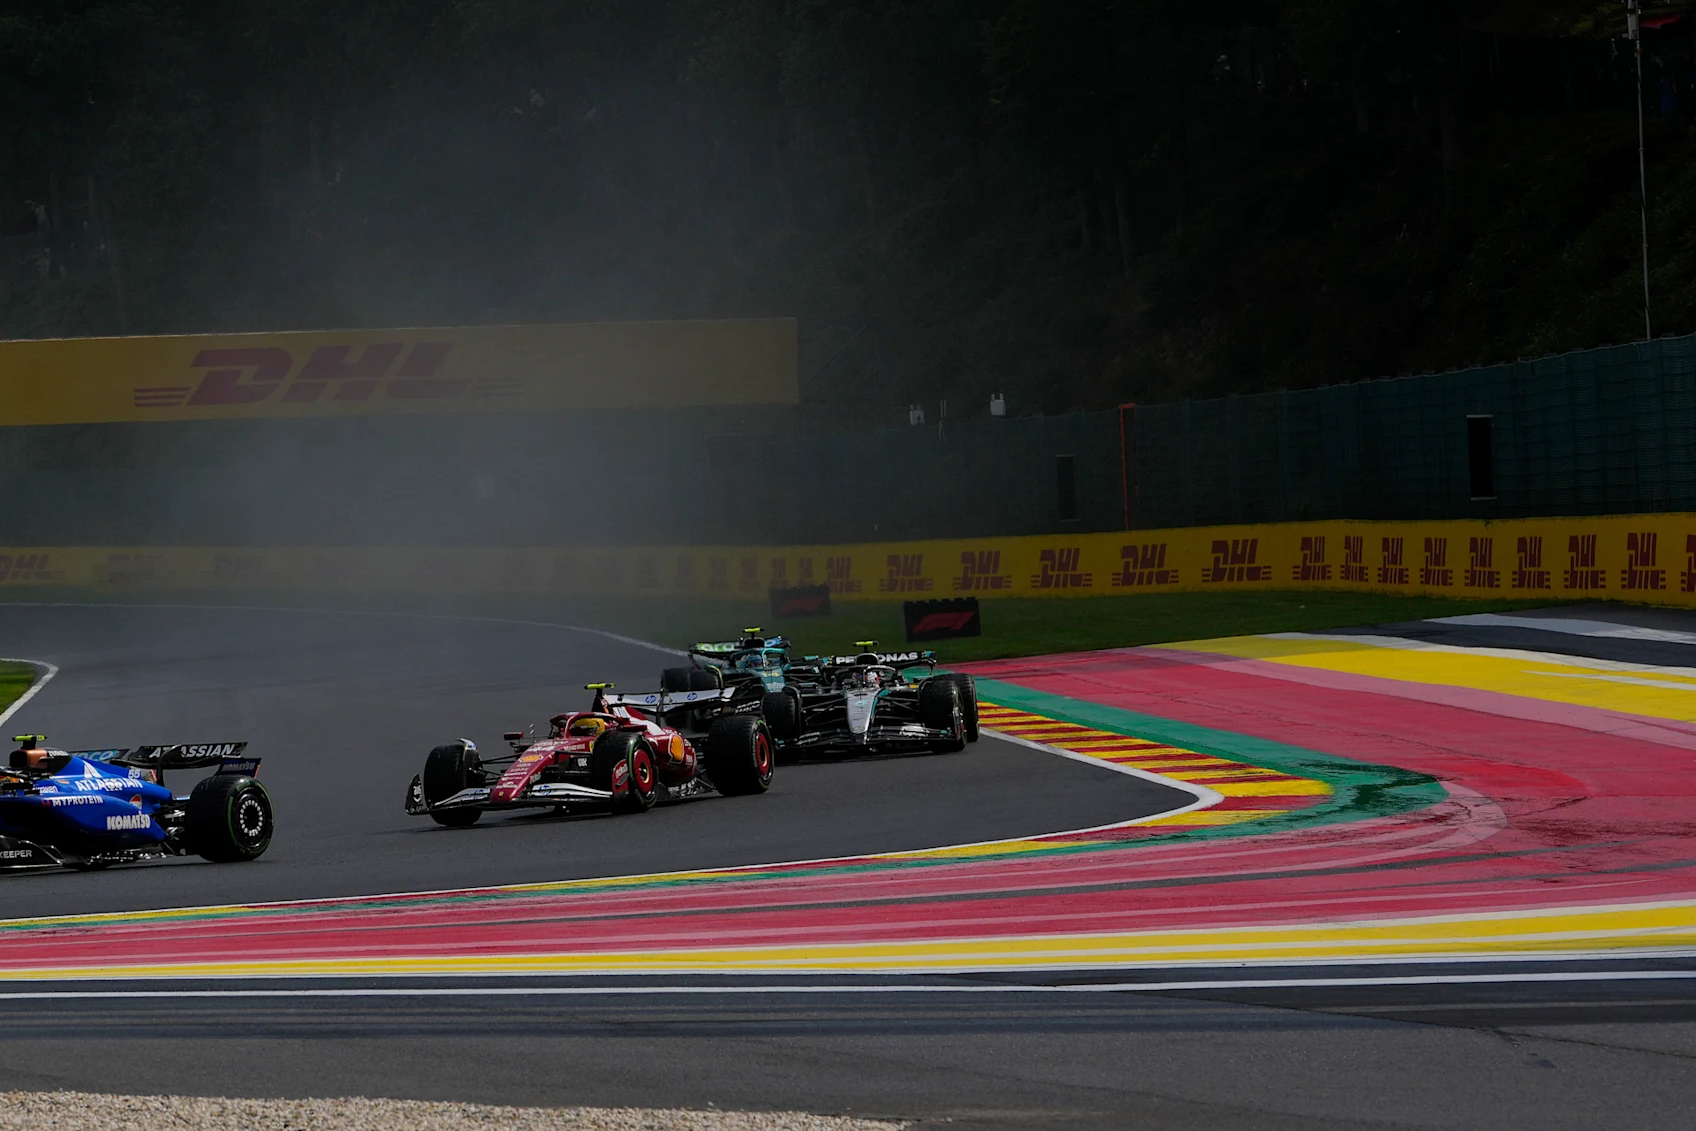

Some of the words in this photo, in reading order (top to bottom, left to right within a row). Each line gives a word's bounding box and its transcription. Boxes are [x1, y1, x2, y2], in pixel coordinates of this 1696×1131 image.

[186, 341, 474, 408] DHL
[886, 553, 924, 592] DHL
[960, 550, 1002, 589] DHL
[1039, 547, 1082, 589] DHL
[1121, 543, 1170, 587] DHL
[1210, 538, 1262, 582] DHL
[1300, 536, 1327, 581] DHL
[1344, 535, 1364, 582] DHL
[1382, 537, 1405, 585] DHL
[1423, 537, 1448, 586] DHL
[1469, 537, 1495, 588] DHL
[1516, 536, 1545, 590] DHL
[1568, 534, 1599, 590] DHL
[1626, 532, 1660, 590] DHL
[52, 795, 104, 807] MYPROTEIN
[106, 811, 151, 831] KOMATSU
